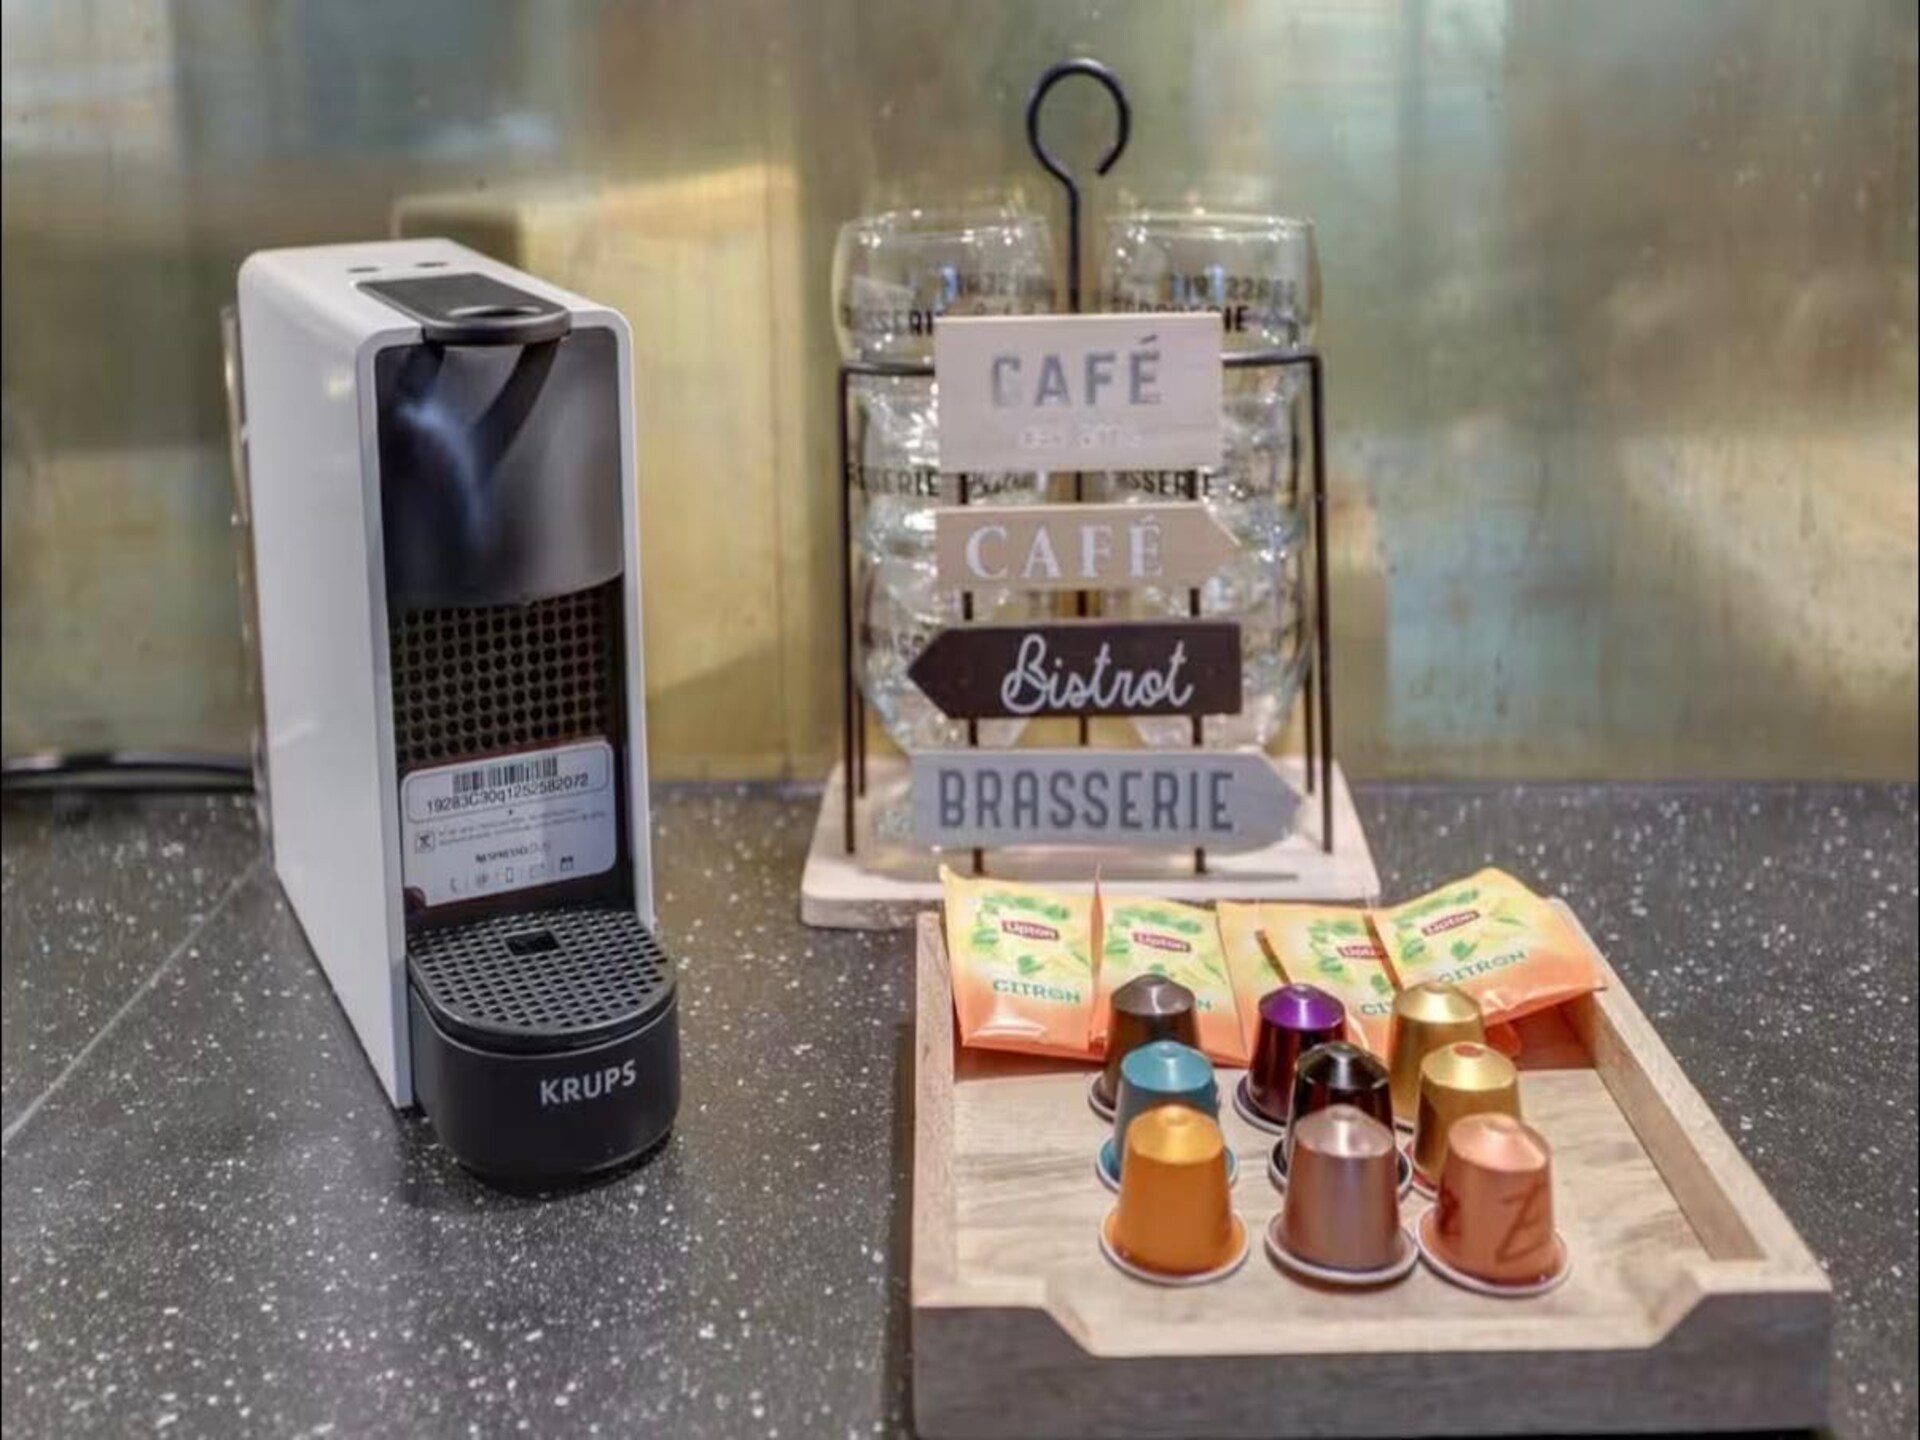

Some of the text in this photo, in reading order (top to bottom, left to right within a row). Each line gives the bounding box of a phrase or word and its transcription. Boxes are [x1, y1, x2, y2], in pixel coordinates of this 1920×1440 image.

[992, 334, 1160, 405] CAFÉ
[966, 514, 1162, 578] CAFÉ
[1001, 633, 1194, 713] Bistrot
[938, 767, 1234, 831] BRASSERIE
[992, 980, 1080, 1003] CITRON
[1438, 951, 1525, 983] CITRON
[539, 1059, 637, 1107] KRUPS
